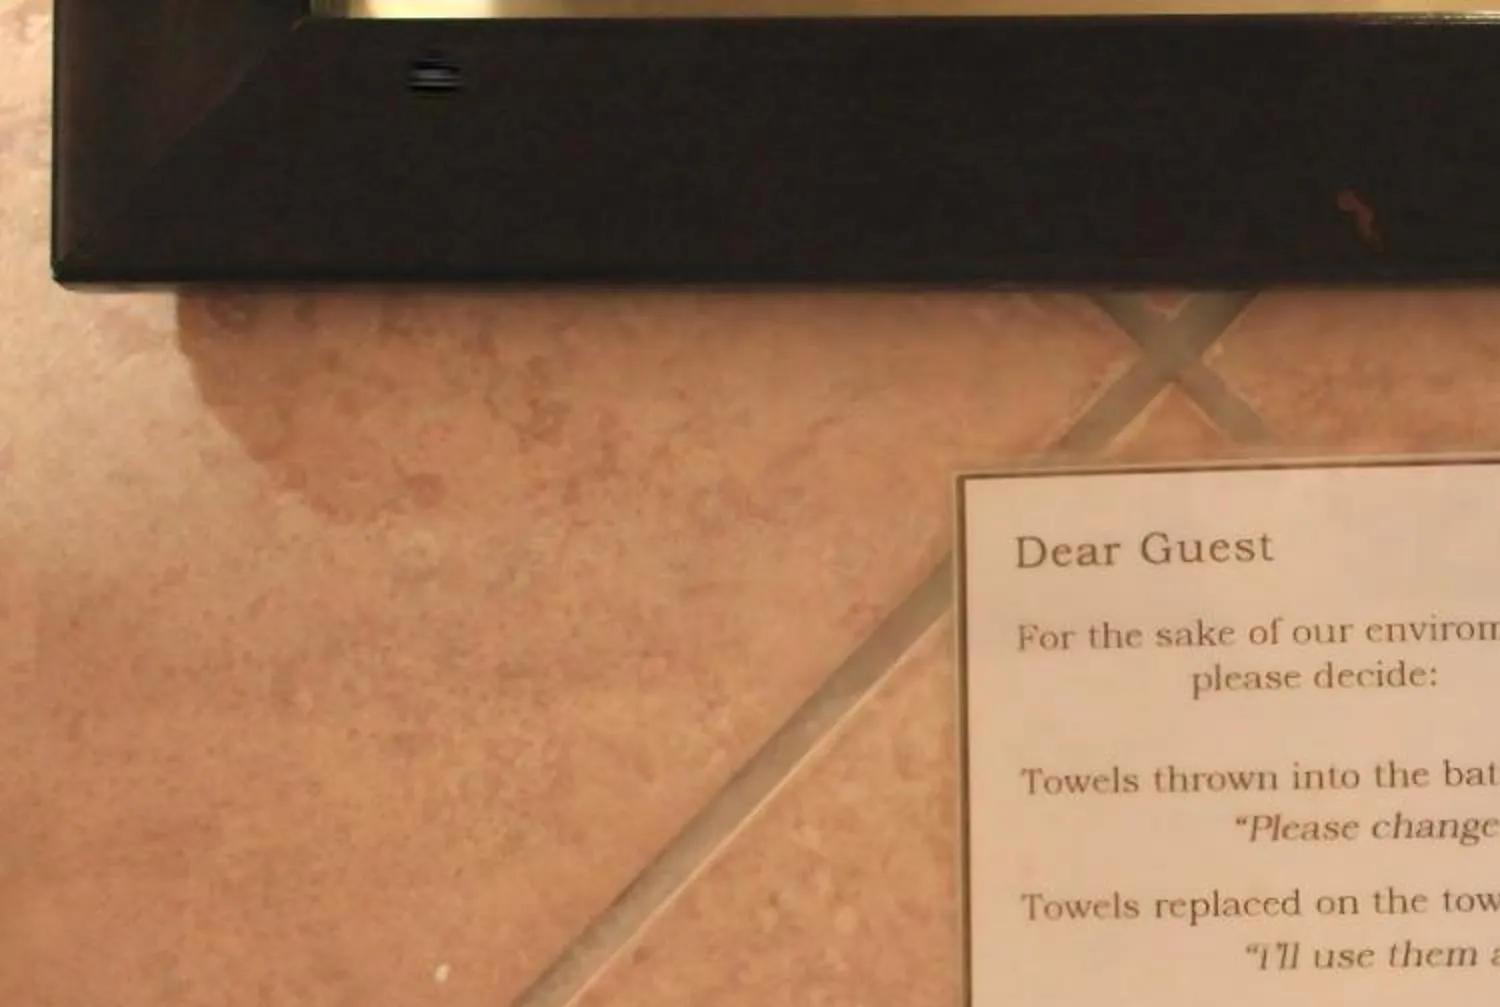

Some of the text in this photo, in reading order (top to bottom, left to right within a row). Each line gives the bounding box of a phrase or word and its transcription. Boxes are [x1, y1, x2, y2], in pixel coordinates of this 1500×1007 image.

[1015, 530, 1275, 569] Dear Guest
[1017, 623, 1077, 652] For
[1087, 621, 1143, 650] the
[1155, 617, 1235, 648] sake
[1248, 616, 1283, 646] of
[1290, 620, 1354, 645] our
[1191, 659, 1438, 701] please decide:
[1020, 764, 1140, 796] Towels
[1153, 763, 1279, 793] thrown
[1292, 761, 1361, 791] into
[1374, 759, 1430, 789] the
[1235, 812, 1360, 844] “Please
[1371, 810, 1500, 847] change
[1020, 890, 1141, 922] Towels
[1154, 887, 1302, 928] replaced
[1315, 895, 1360, 917] on
[1372, 885, 1429, 915] the
[1313, 948, 1376, 970] use
[1388, 939, 1478, 969] them
